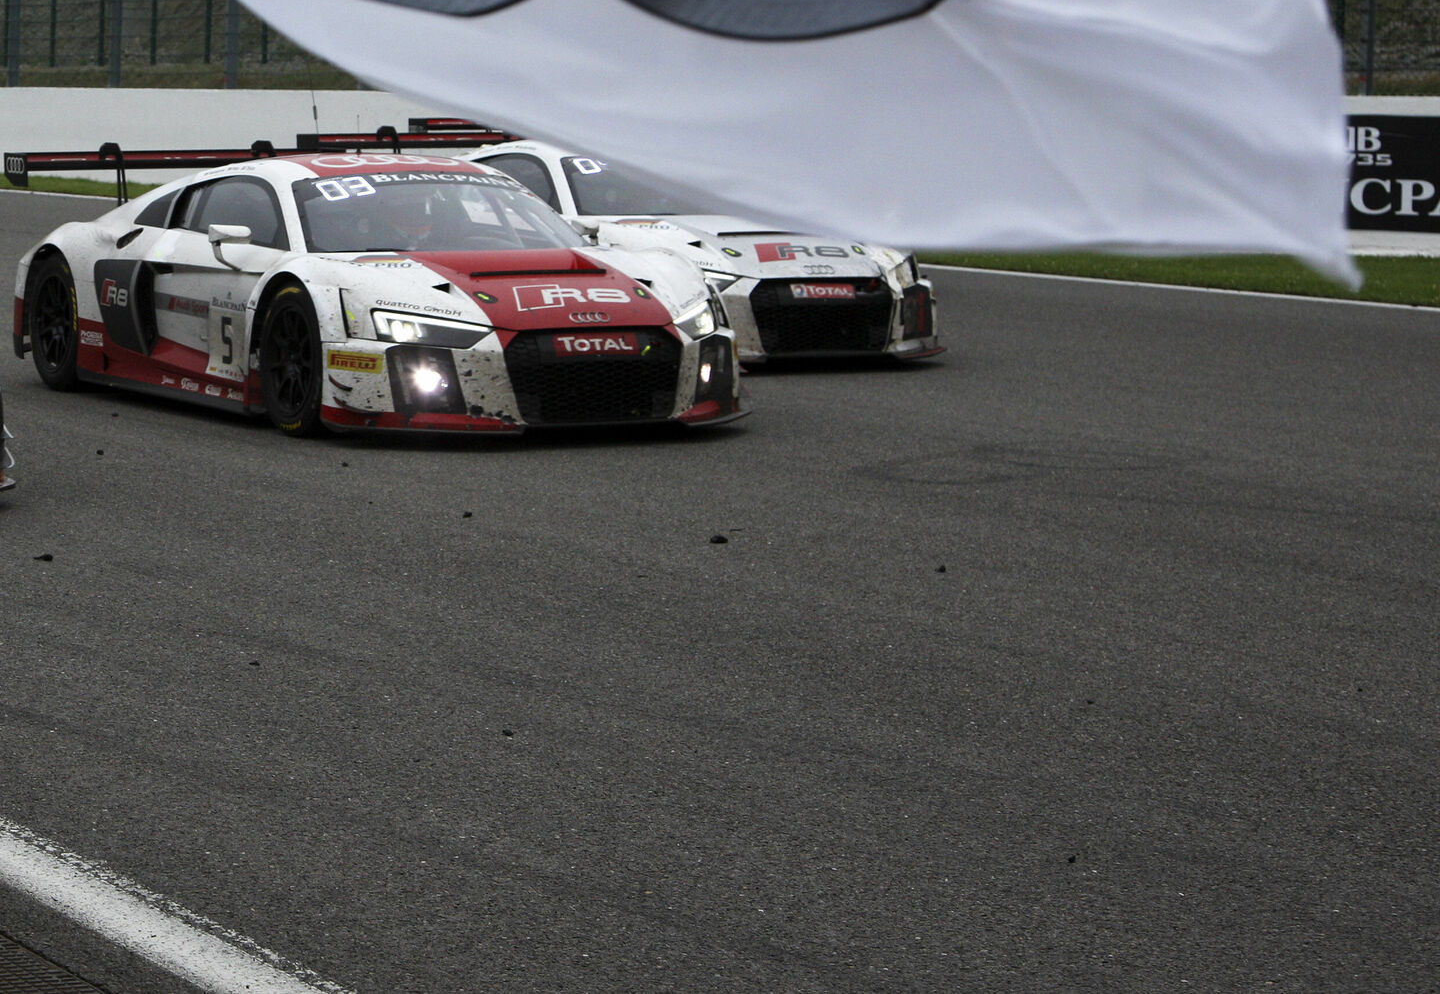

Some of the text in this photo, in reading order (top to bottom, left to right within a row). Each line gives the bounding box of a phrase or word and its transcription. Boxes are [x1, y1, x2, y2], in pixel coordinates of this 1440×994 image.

[316, 176, 376, 201] 03
[1350, 177, 1440, 216] CP
[775, 244, 849, 258] R8
[106, 285, 129, 307] R8
[539, 287, 632, 305] R8
[807, 285, 852, 297] TOTAL
[375, 298, 463, 317] quattro GmbH
[221, 316, 234, 365] 5
[557, 336, 633, 352] TOTAL
[330, 353, 377, 370] PIRELLI
